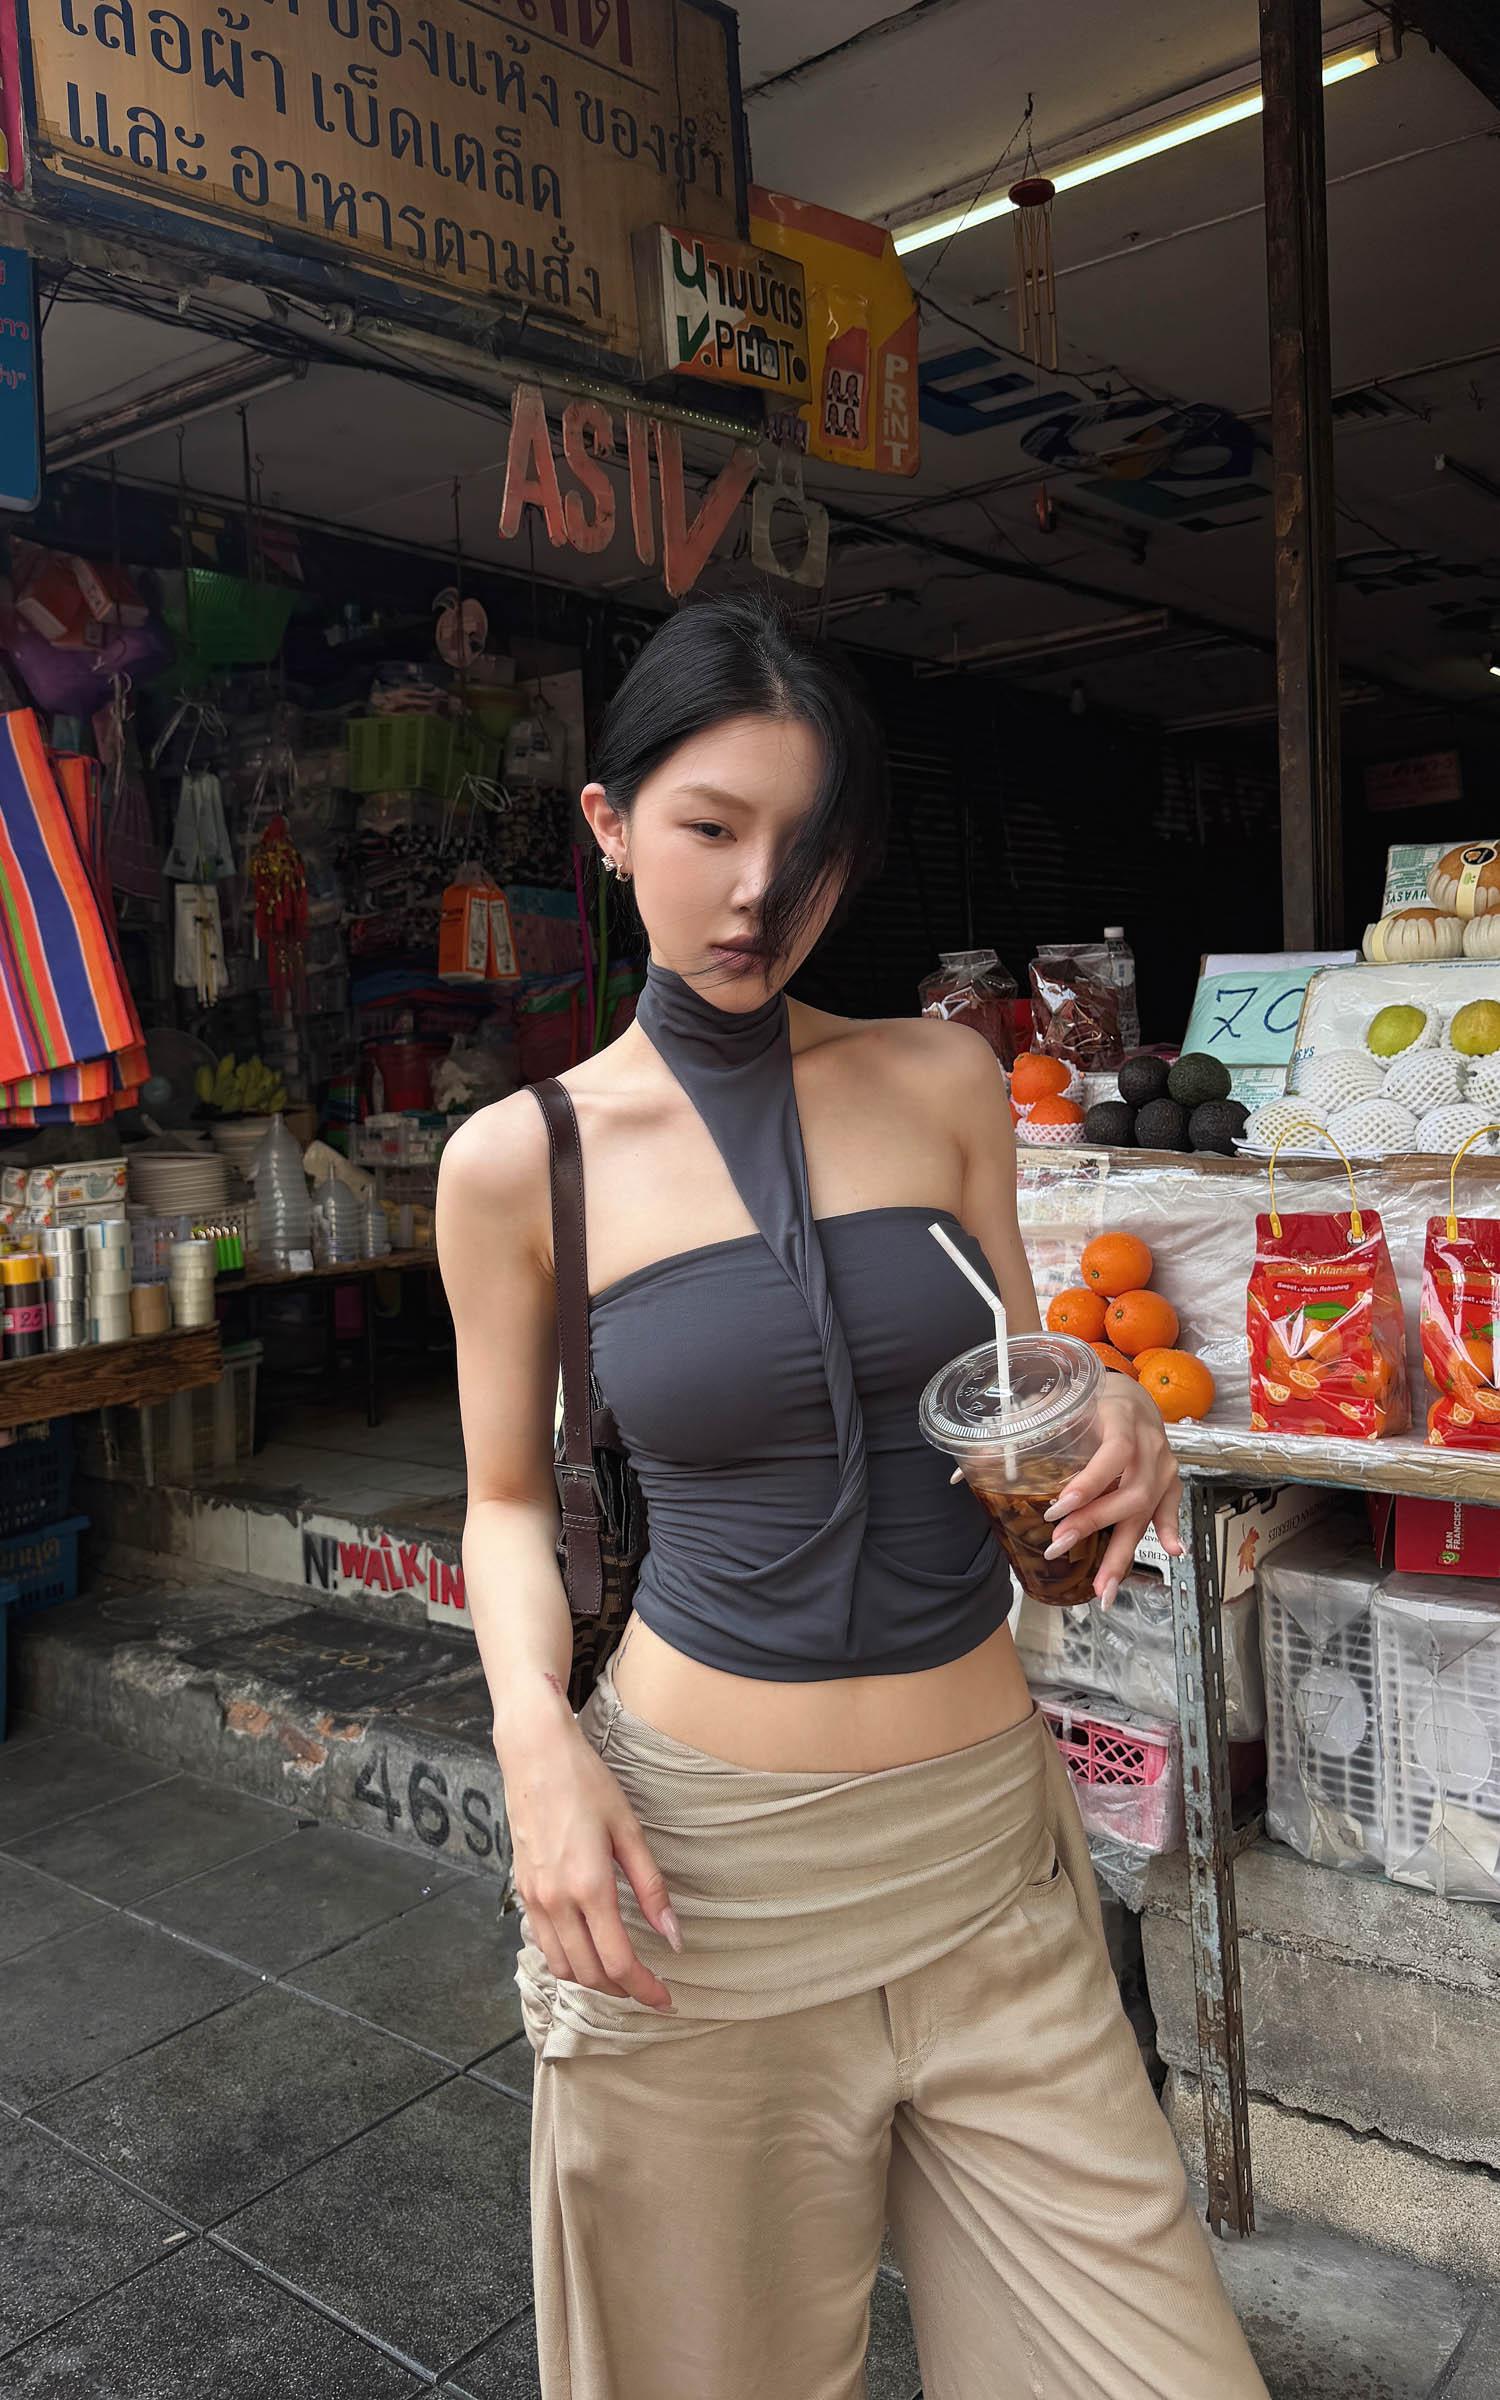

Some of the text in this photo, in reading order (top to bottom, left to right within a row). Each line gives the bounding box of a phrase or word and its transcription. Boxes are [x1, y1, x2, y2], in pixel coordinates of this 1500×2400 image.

[312, 64, 562, 218] เบ็ดเตล็ด
[67, 82, 601, 317] และ อาหารตามสั่ง
[672, 237, 803, 329] นามบัตร
[338, 1534, 427, 1591] WALK
[1445, 1531, 1453, 1550] SAN
